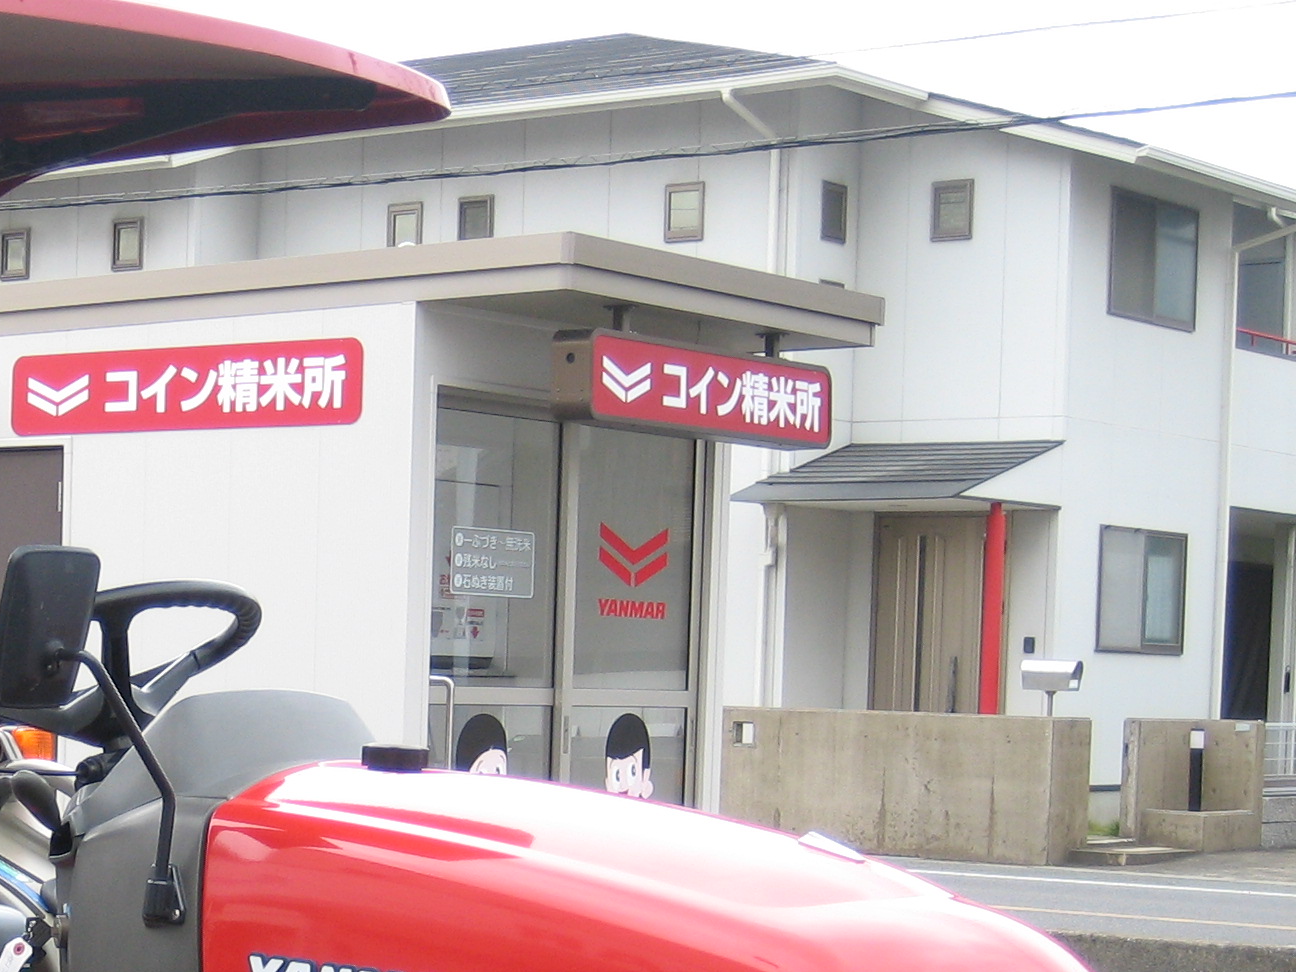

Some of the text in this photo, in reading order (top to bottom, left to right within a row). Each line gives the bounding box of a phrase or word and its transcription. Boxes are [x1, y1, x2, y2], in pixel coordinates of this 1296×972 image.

[103, 353, 347, 414] コイン精米所
[661, 363, 822, 433] コイン精米所
[598, 597, 667, 620] YANMAR
